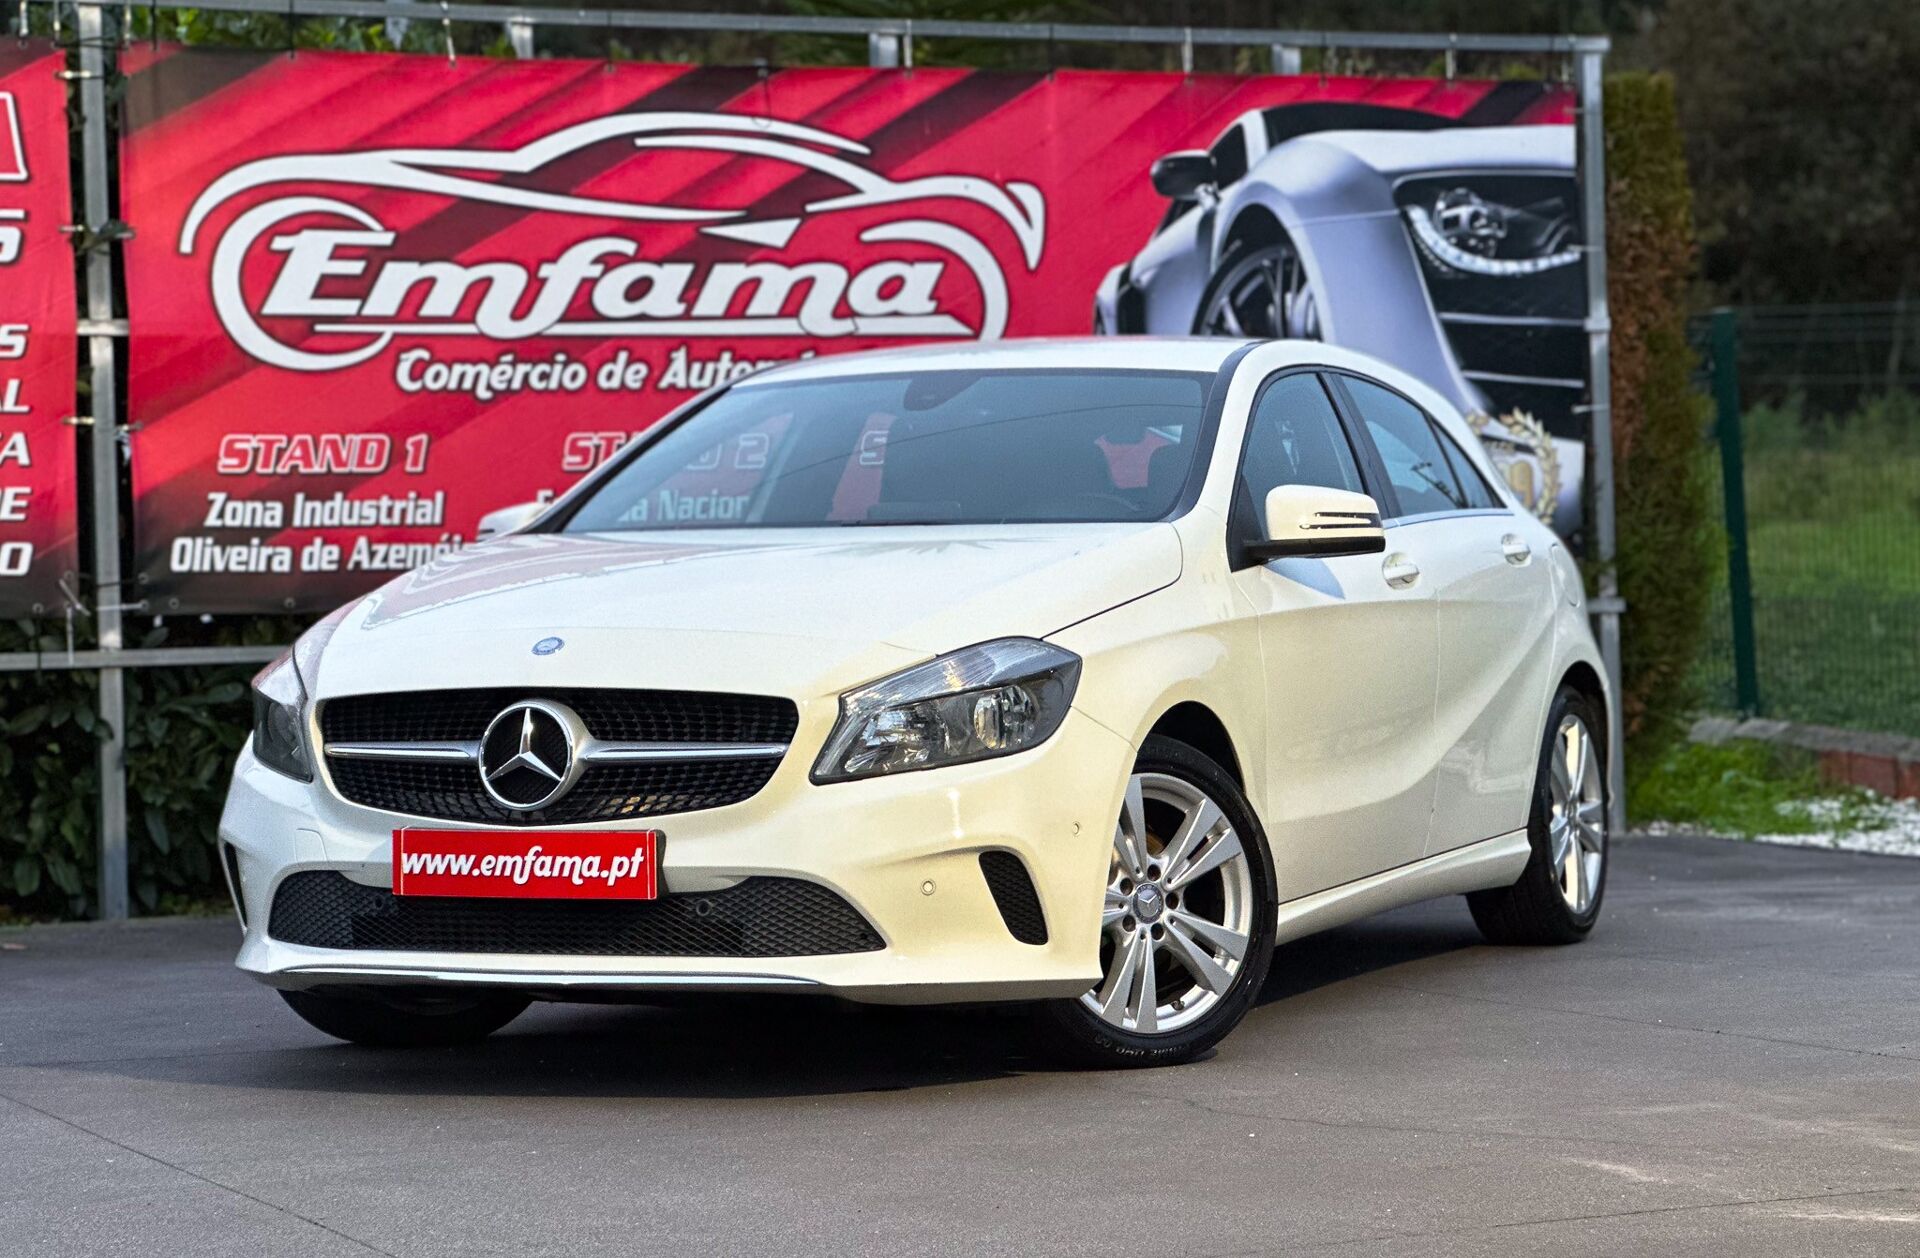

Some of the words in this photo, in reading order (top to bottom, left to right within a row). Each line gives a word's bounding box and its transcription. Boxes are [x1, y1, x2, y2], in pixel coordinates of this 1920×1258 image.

[261, 230, 946, 338] Emfama
[396, 348, 587, 398] Comércio
[597, 350, 648, 391] de
[217, 433, 391, 474] STAND
[405, 432, 431, 473] 1
[204, 491, 284, 528] Zona
[292, 489, 445, 528] Industrial
[170, 536, 293, 573] Oliveira
[301, 536, 341, 572] de
[402, 845, 645, 887] www.emfama.pt
